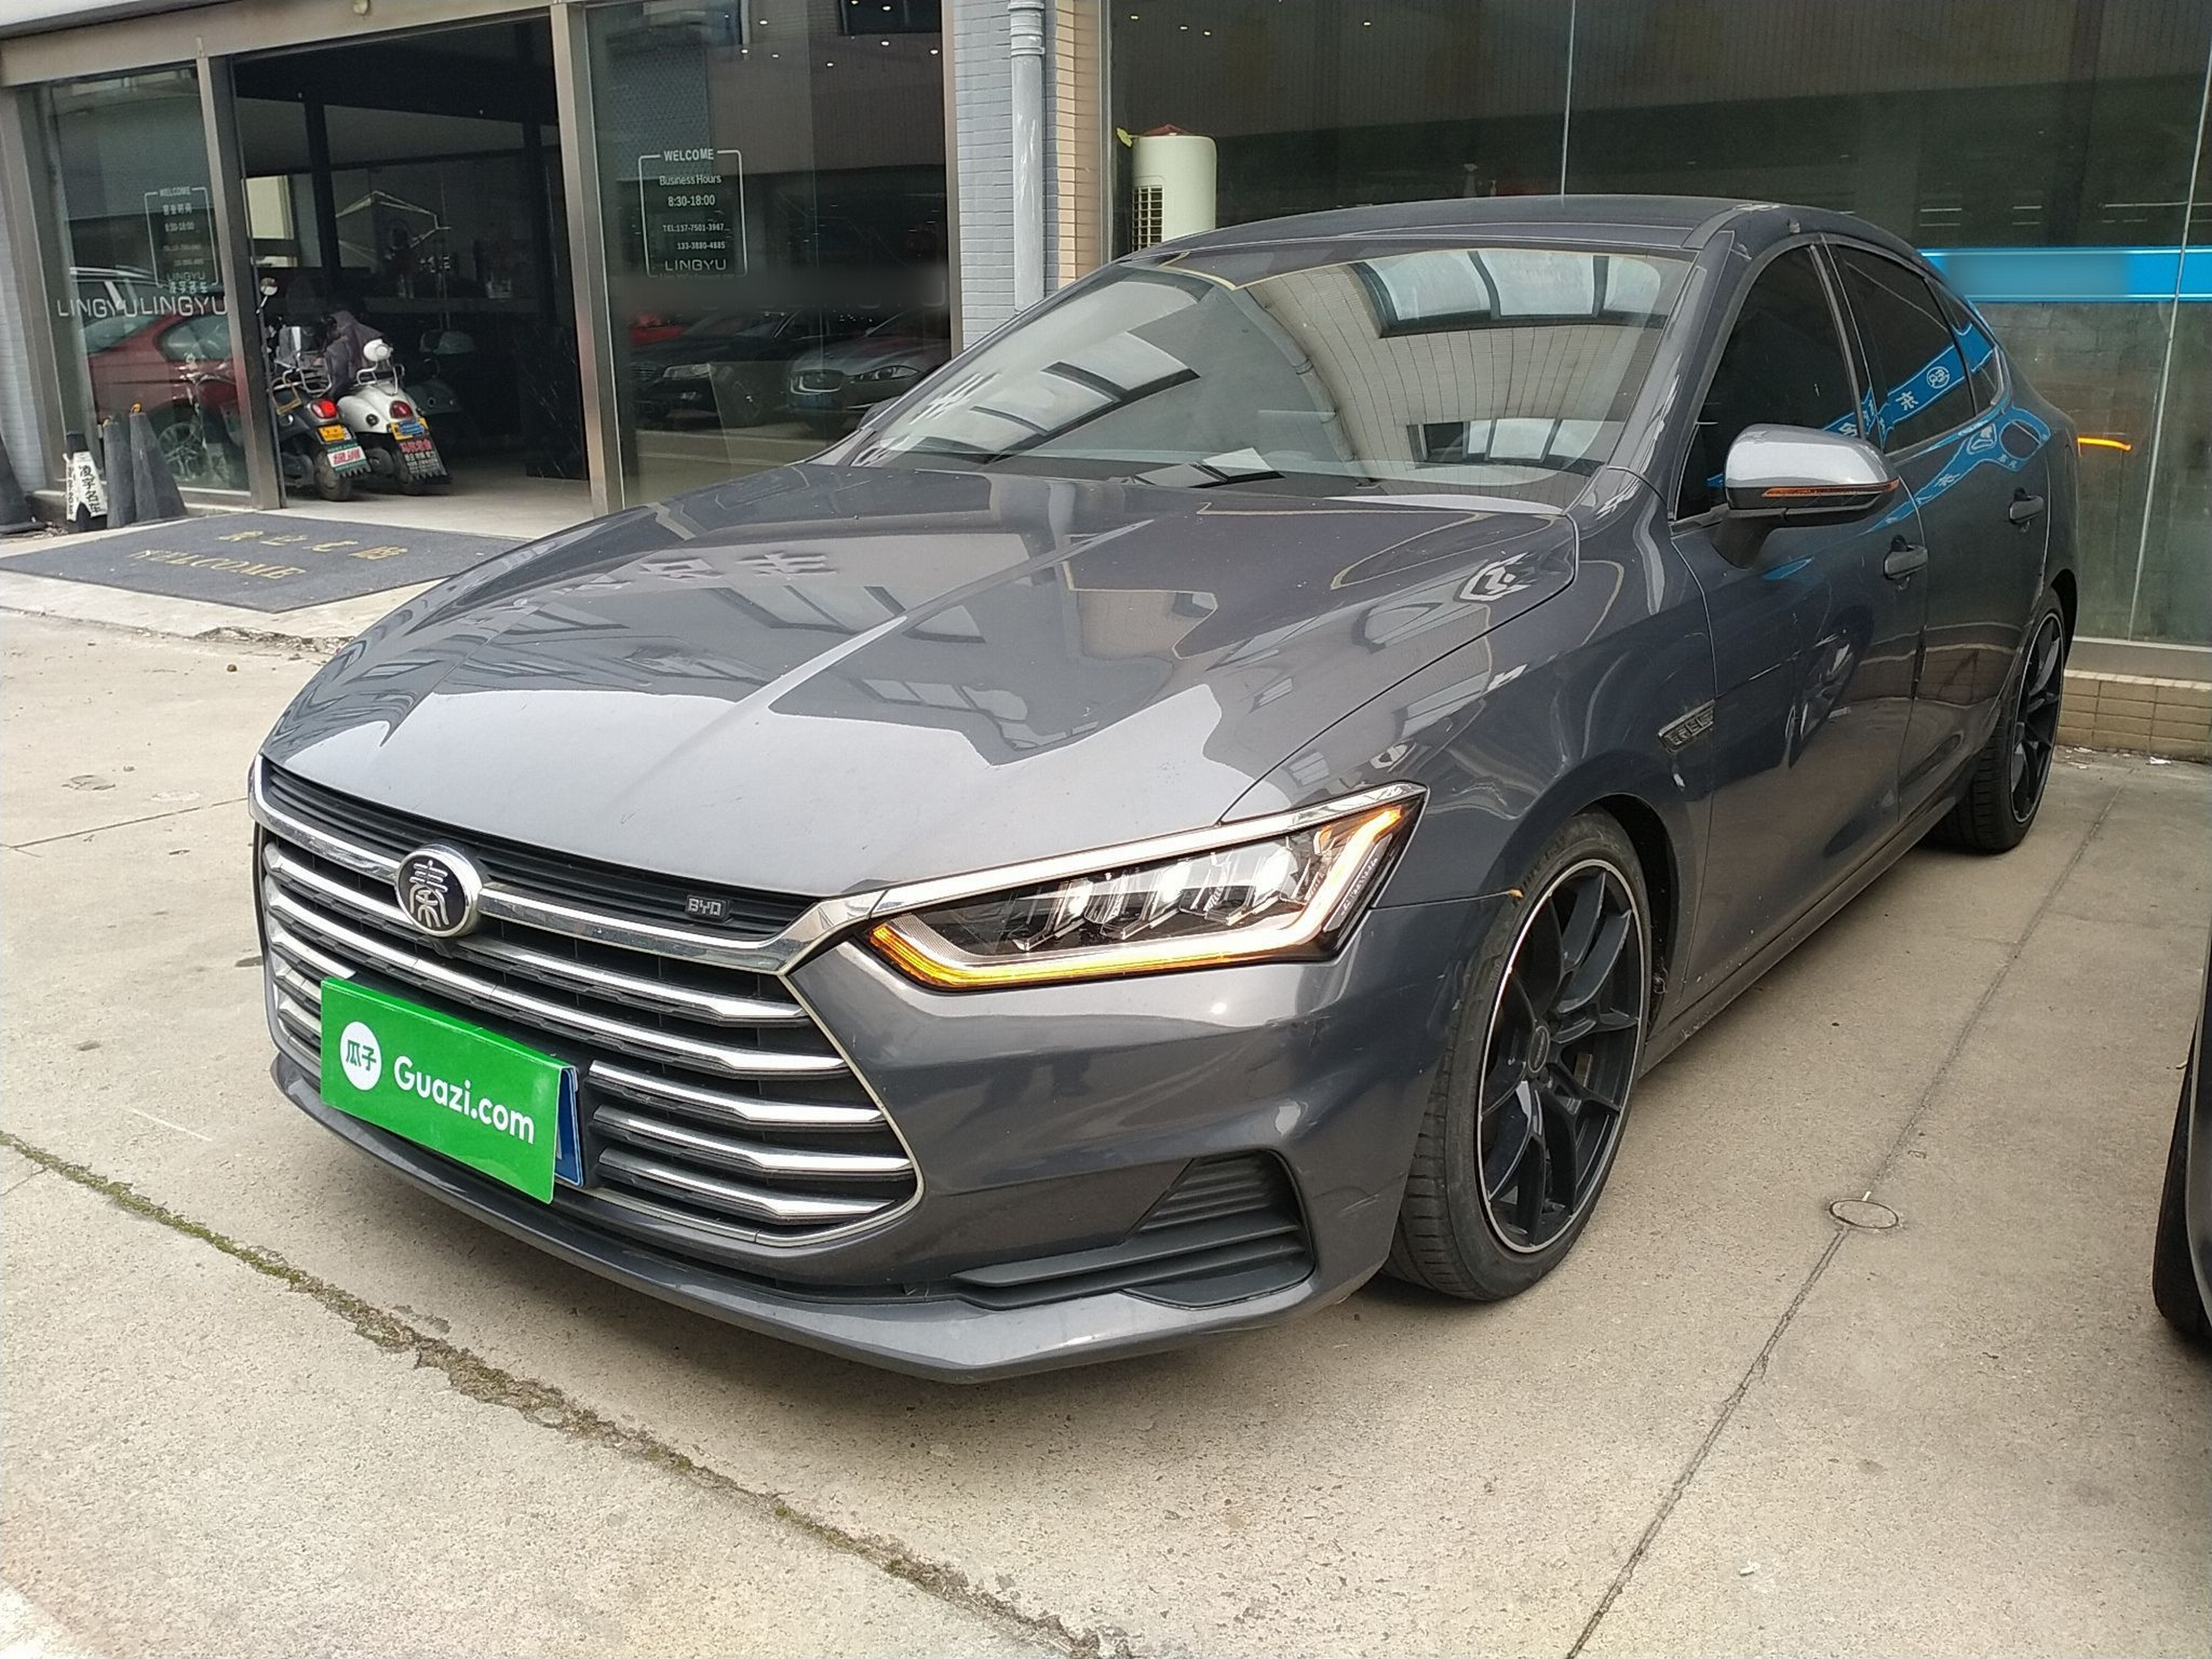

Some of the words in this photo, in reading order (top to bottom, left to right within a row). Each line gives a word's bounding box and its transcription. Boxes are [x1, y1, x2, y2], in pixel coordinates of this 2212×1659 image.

[664, 147, 714, 162] WELCOME
[659, 176, 695, 186] Business
[696, 174, 722, 184] Hours
[668, 195, 715, 207] 8:30-18:00
[664, 259, 726, 271] LINGYU
[139, 296, 228, 316] LINGYU
[688, 898, 721, 916] BYD
[345, 1039, 377, 1072] 瓜子
[393, 1055, 535, 1145] Guazi.com
